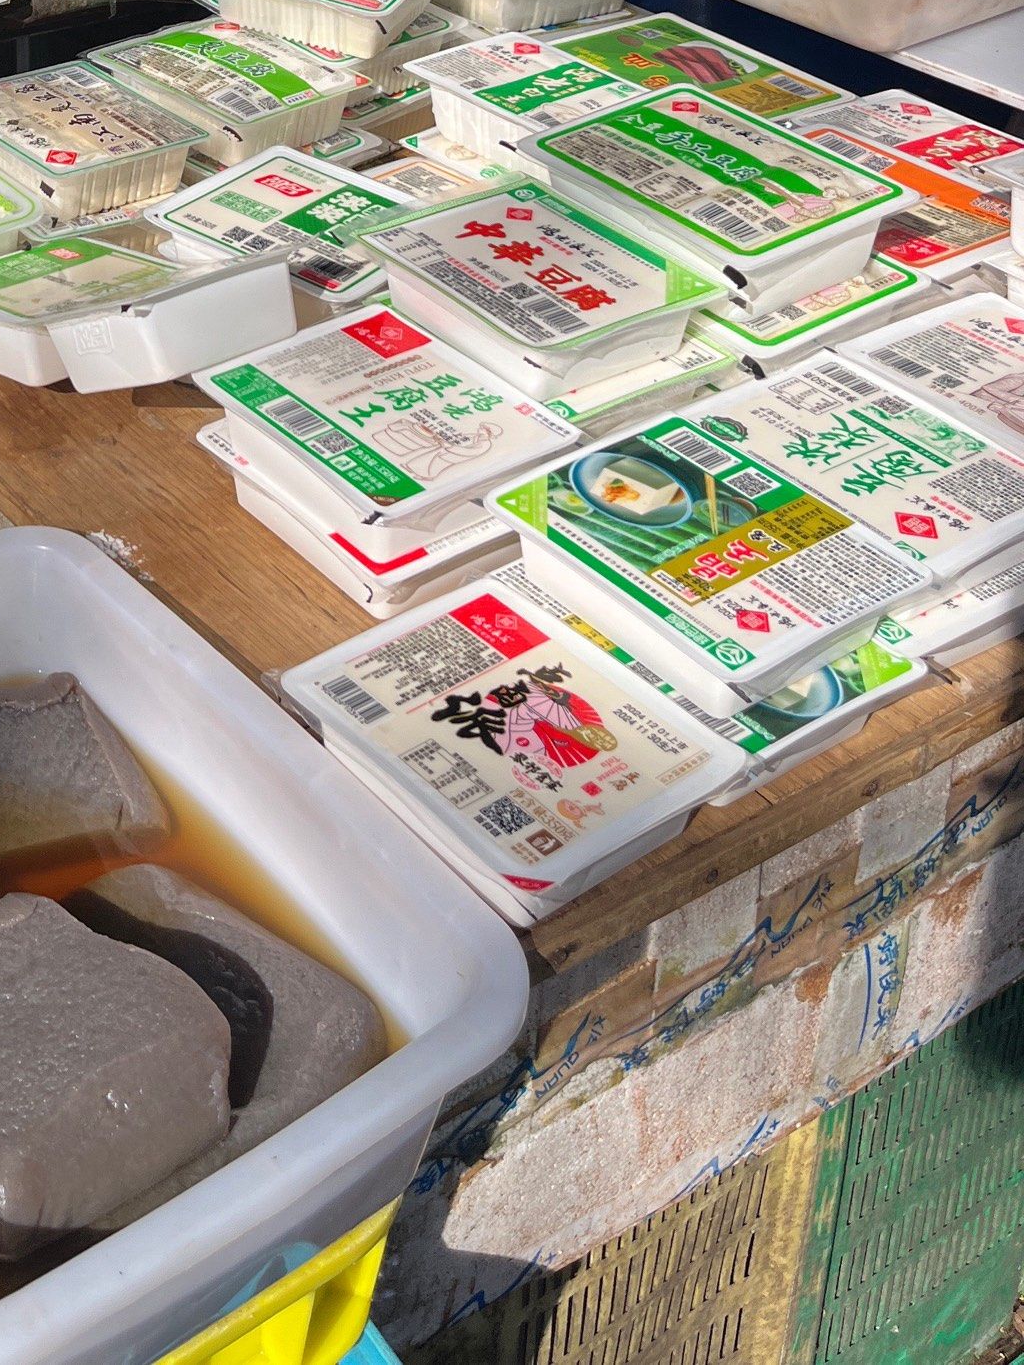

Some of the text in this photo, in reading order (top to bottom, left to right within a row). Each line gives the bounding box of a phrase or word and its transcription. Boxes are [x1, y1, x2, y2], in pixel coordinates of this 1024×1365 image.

[372, 360, 436, 387] TOFU KING
[337, 370, 463, 429] 豆腐王
[440, 385, 506, 422] 鸿光
[780, 413, 882, 468] 浓浆
[840, 448, 939, 499] 豆腐
[692, 540, 769, 582] 晶玉
[750, 529, 786, 553] 豆腐
[663, 611, 710, 646] 绿色食品
[712, 603, 736, 620] 2024
[611, 707, 637, 726] 2024
[643, 731, 679, 758] 30生产
[622, 702, 689, 751] 2024 12 01上市
[596, 760, 631, 786] Chinese
[599, 754, 620, 769] Tofu
[507, 786, 576, 843] 净含量:350克
[970, 796, 1008, 835] QUAN
[534, 1050, 580, 1100] QUAN
